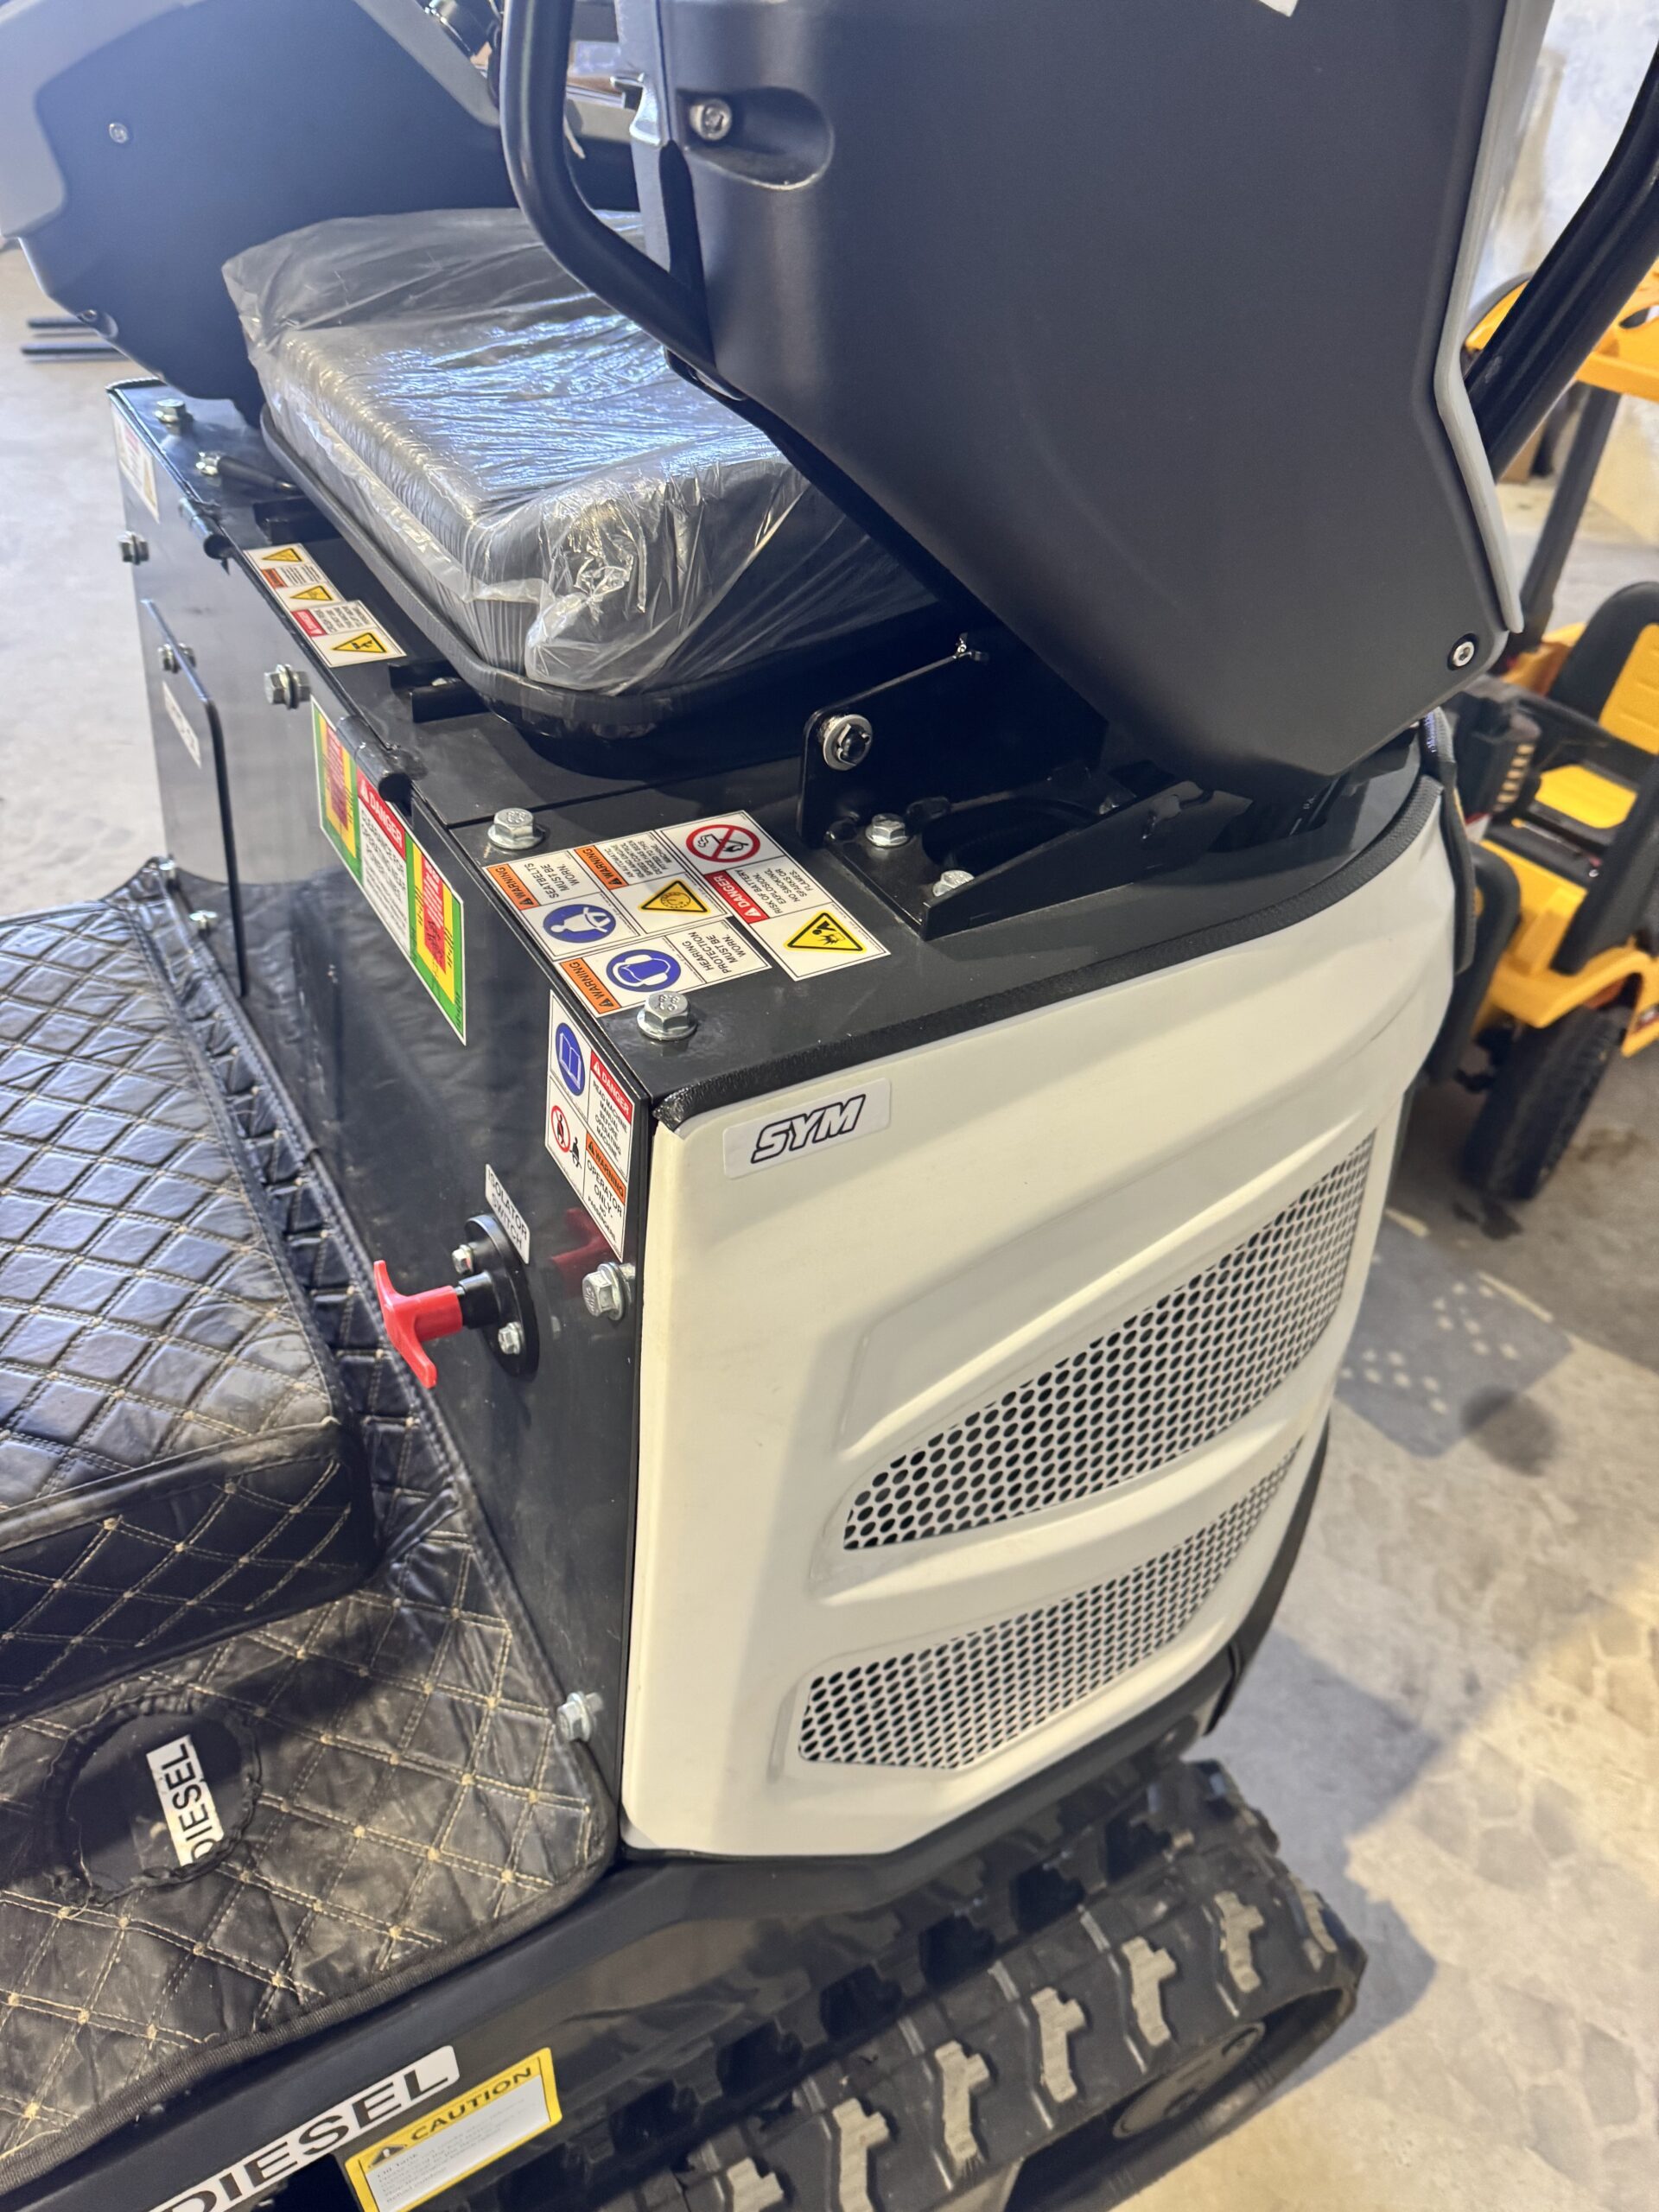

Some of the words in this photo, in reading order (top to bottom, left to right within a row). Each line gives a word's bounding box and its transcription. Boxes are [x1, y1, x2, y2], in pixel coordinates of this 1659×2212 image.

[369, 791, 402, 848] DANGER
[582, 848, 614, 879] WARNING
[603, 848, 629, 872] AUTOMATIC
[620, 842, 641, 862] CONTROL
[494, 866, 526, 899] WARNING
[526, 862, 560, 899] SEATBELTS
[539, 863, 554, 873] BE
[547, 873, 569, 892] MUST
[556, 863, 580, 886] WORN.
[734, 868, 762, 892] BATTERY
[774, 868, 786, 876] OR
[788, 868, 812, 891] FLAMES.
[713, 875, 751, 908] DANGER
[752, 871, 786, 904] EXPLOSION.
[756, 892, 770, 900] OF
[782, 875, 807, 897] SPARKS
[787, 893, 800, 902] NO
[765, 899, 783, 913] RISK
[687, 931, 732, 974] PROTECTION
[705, 934, 721, 944] BE
[714, 944, 738, 963] MUST
[721, 933, 746, 957] WORN.
[681, 940, 714, 970] HEARING
[569, 961, 605, 1000] WARNING
[592, 1079, 606, 1102] READ
[605, 1098, 626, 1133] MACHINE
[601, 1071, 629, 1116] DANGER
[599, 1100, 619, 1132] MANUAL
[599, 1109, 618, 1141] BEFORE
[751, 1094, 866, 1164] SYM
[594, 1114, 621, 1155] OPERATING
[587, 1159, 622, 1217] OPERATOR
[594, 1149, 624, 1198] WARNING
[488, 1169, 527, 1240] ISOLATOR
[599, 1204, 607, 1217] NO
[491, 1192, 522, 1249] SWITCH
[410, 2067, 531, 2140] CAUTION
